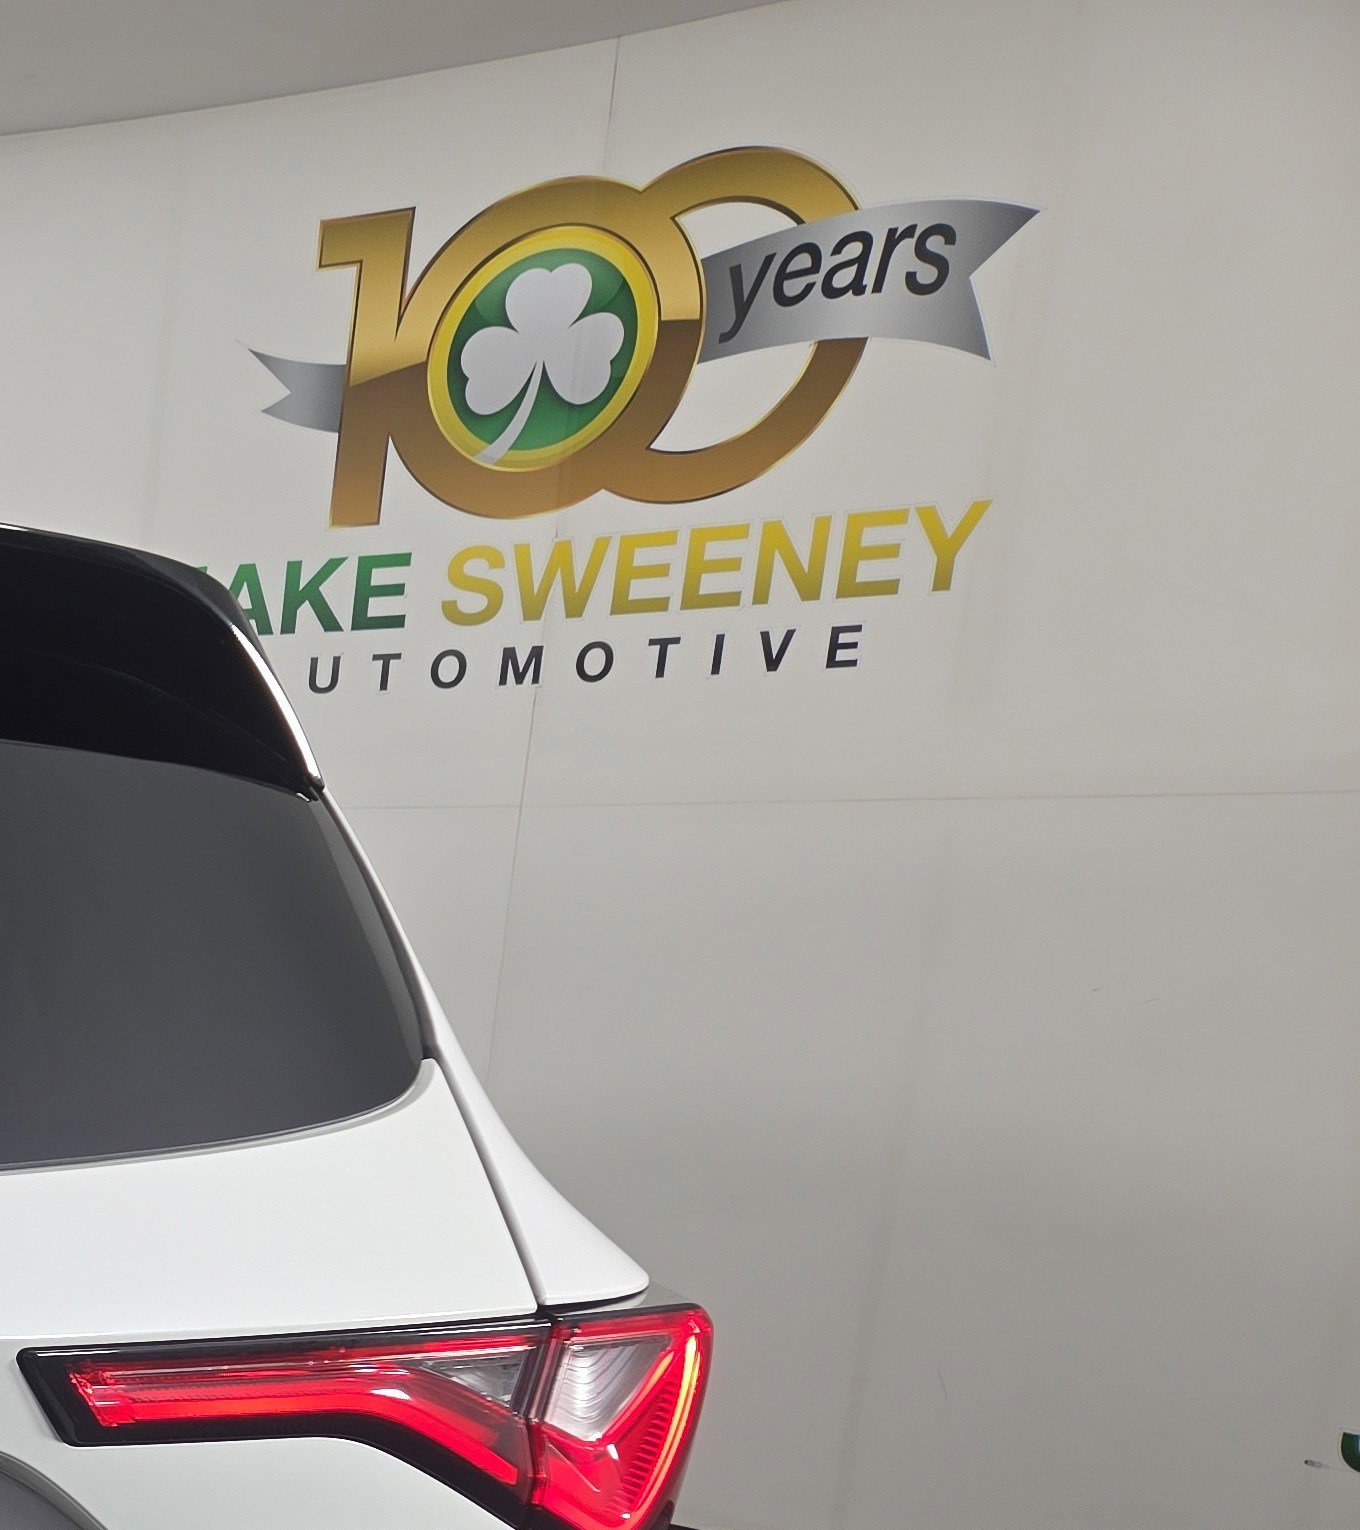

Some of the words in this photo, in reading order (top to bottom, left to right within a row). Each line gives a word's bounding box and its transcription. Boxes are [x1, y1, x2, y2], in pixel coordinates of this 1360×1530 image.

[717, 222, 958, 345] years
[197, 551, 415, 637] AKE
[440, 499, 995, 628] SWEENEY
[307, 624, 865, 696] UTOMOTIVE
